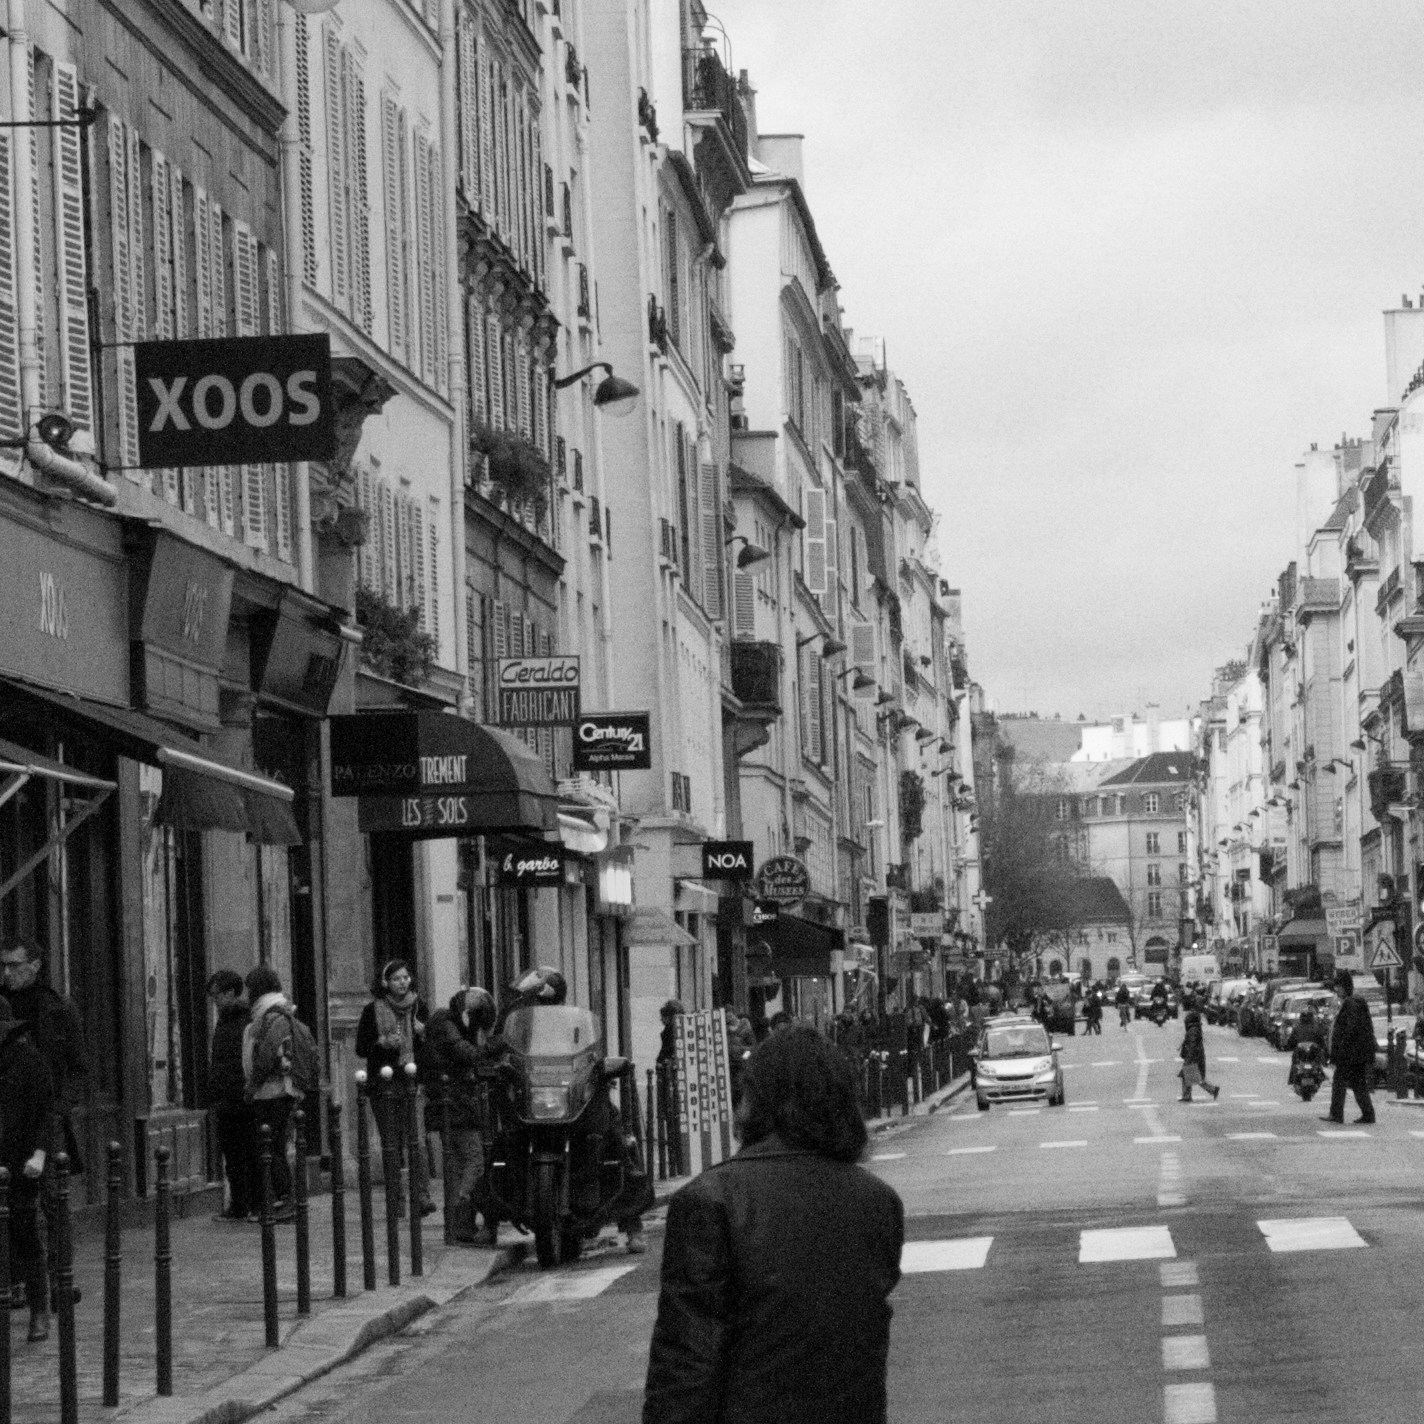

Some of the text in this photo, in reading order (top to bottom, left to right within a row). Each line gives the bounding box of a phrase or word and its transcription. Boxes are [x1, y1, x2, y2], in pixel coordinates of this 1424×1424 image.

[148, 370, 322, 433] XOOS
[501, 660, 579, 684] Geraldo
[503, 690, 577, 722] FABRICANT
[579, 722, 644, 751] Century 21
[402, 796, 468, 826] LES SOLS
[516, 855, 560, 877] garbo
[708, 853, 747, 869] NOA
[1264, 938, 1273, 950] P
[1340, 938, 1350, 954] P
[676, 1014, 689, 1133] LIQUIDATION
[686, 1016, 699, 1132] TOUT DOIT
